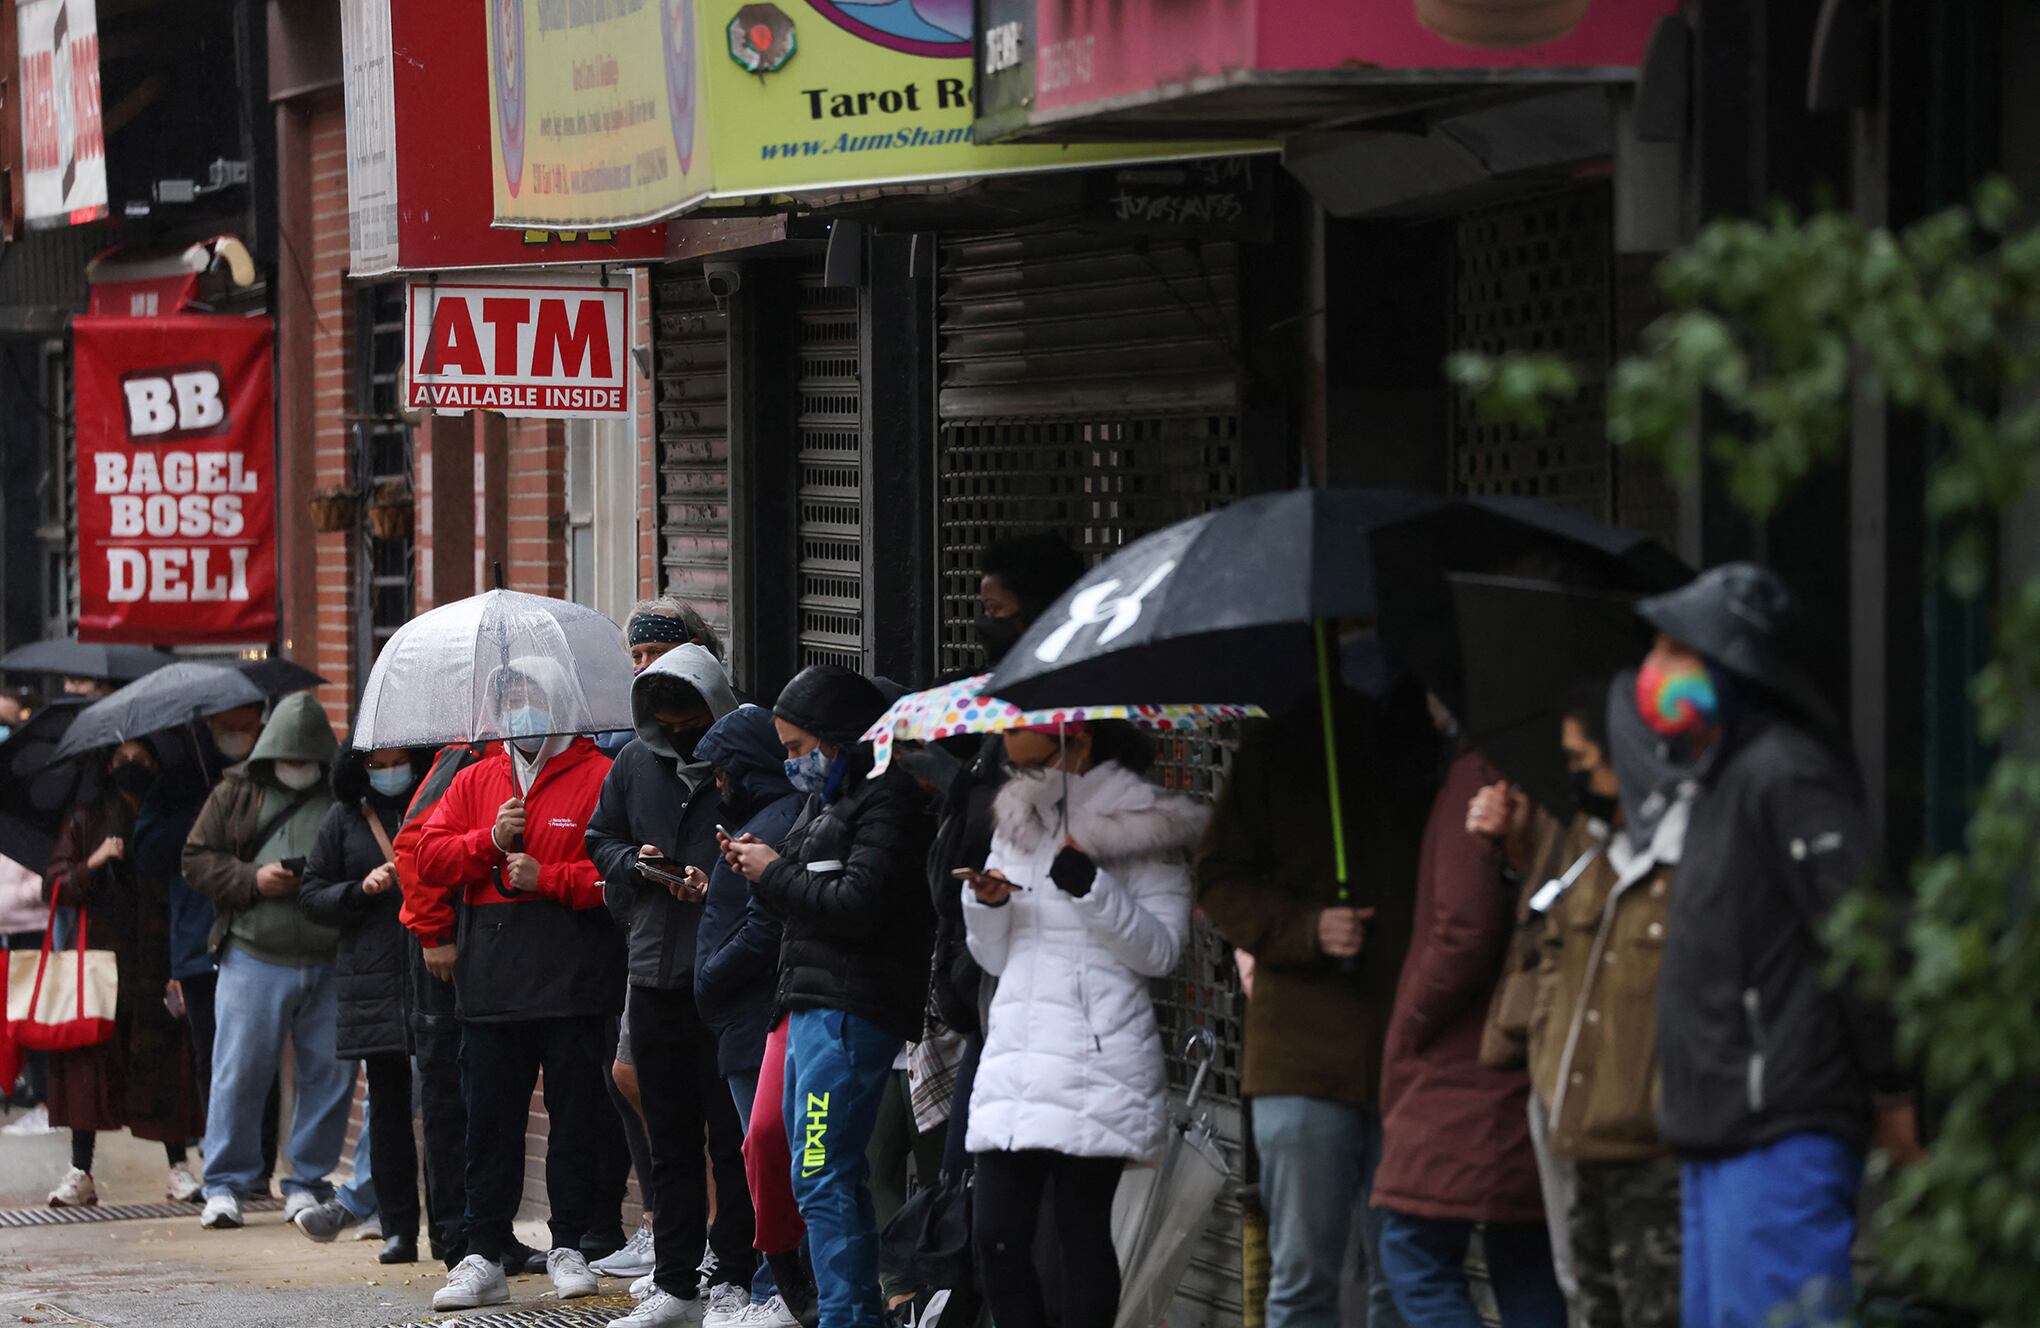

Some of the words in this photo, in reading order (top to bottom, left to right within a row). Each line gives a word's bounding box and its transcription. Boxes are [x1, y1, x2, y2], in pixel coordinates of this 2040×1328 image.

[802, 82, 921, 120] Tarot
[418, 296, 613, 379] ATM
[123, 370, 224, 437] BB
[414, 385, 537, 406] AVAILABLE
[545, 388, 621, 408] INSIDE
[94, 451, 258, 494] BAGEL
[110, 495, 244, 538] BOSS
[106, 547, 249, 603] DELI
[802, 1092, 830, 1167] NIKE
